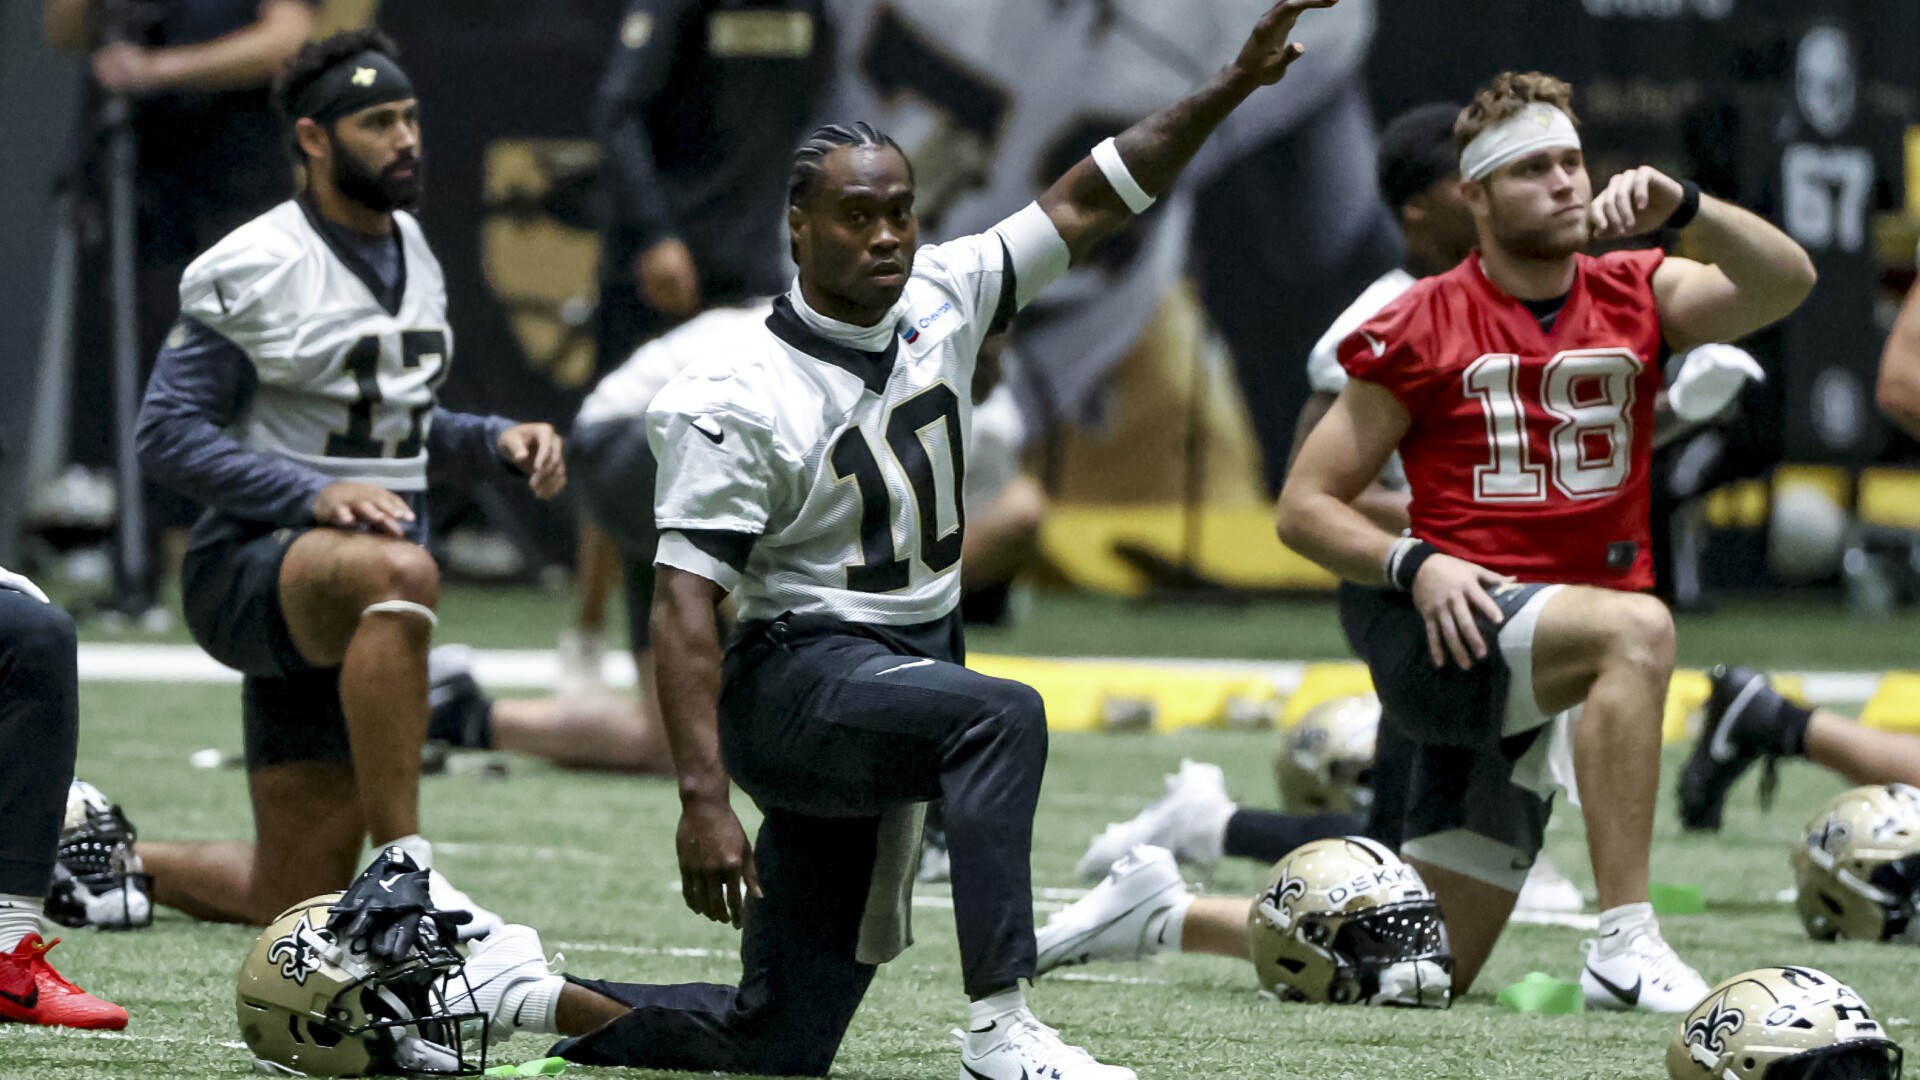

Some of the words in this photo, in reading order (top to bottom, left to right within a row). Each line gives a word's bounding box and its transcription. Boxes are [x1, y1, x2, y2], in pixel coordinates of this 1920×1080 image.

[1782, 145, 1874, 251] 67
[323, 327, 449, 458] 17
[1463, 346, 1645, 502] 18
[828, 377, 966, 594] 10
